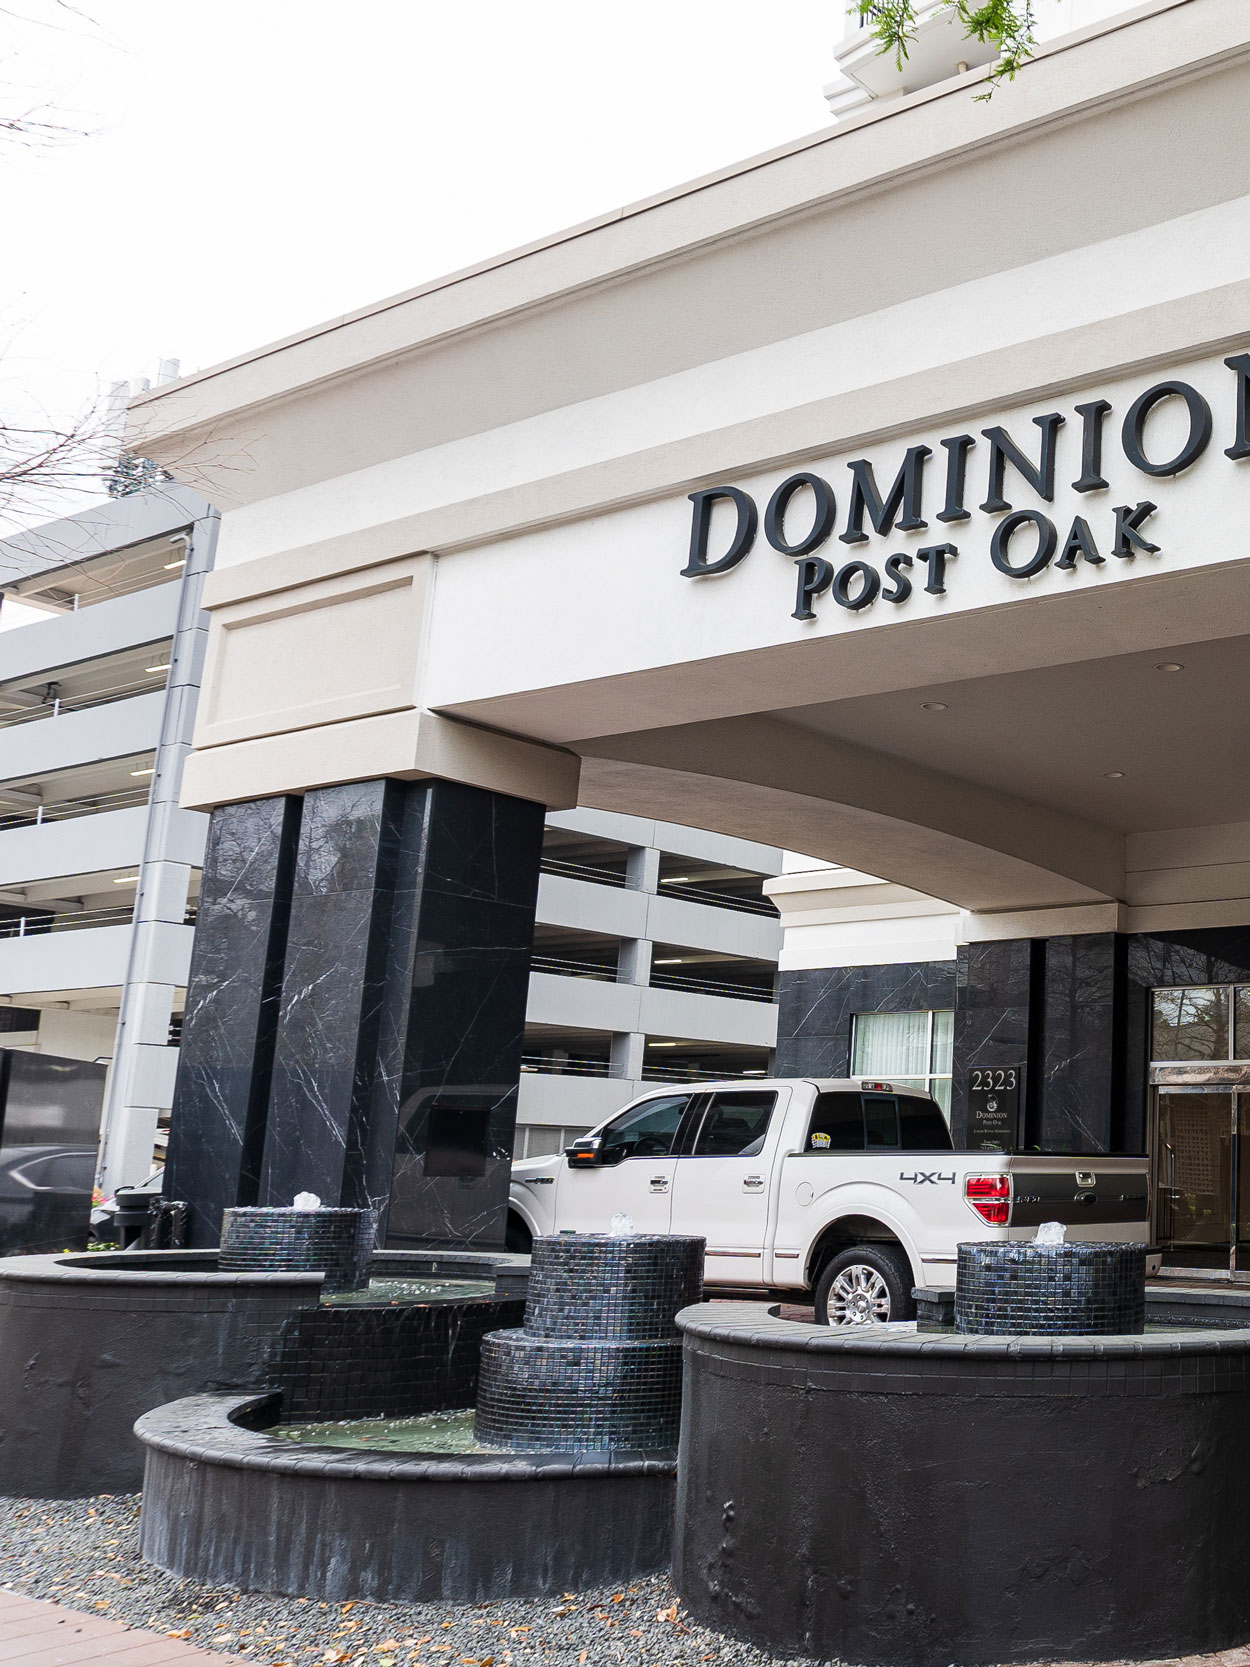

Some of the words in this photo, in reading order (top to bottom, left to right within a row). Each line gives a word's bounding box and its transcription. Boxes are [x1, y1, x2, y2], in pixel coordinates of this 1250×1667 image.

[791, 543, 959, 620] POST
[991, 501, 1162, 579] OAK
[972, 1070, 1016, 1091] 2323
[976, 1111, 1008, 1119] DOMINION
